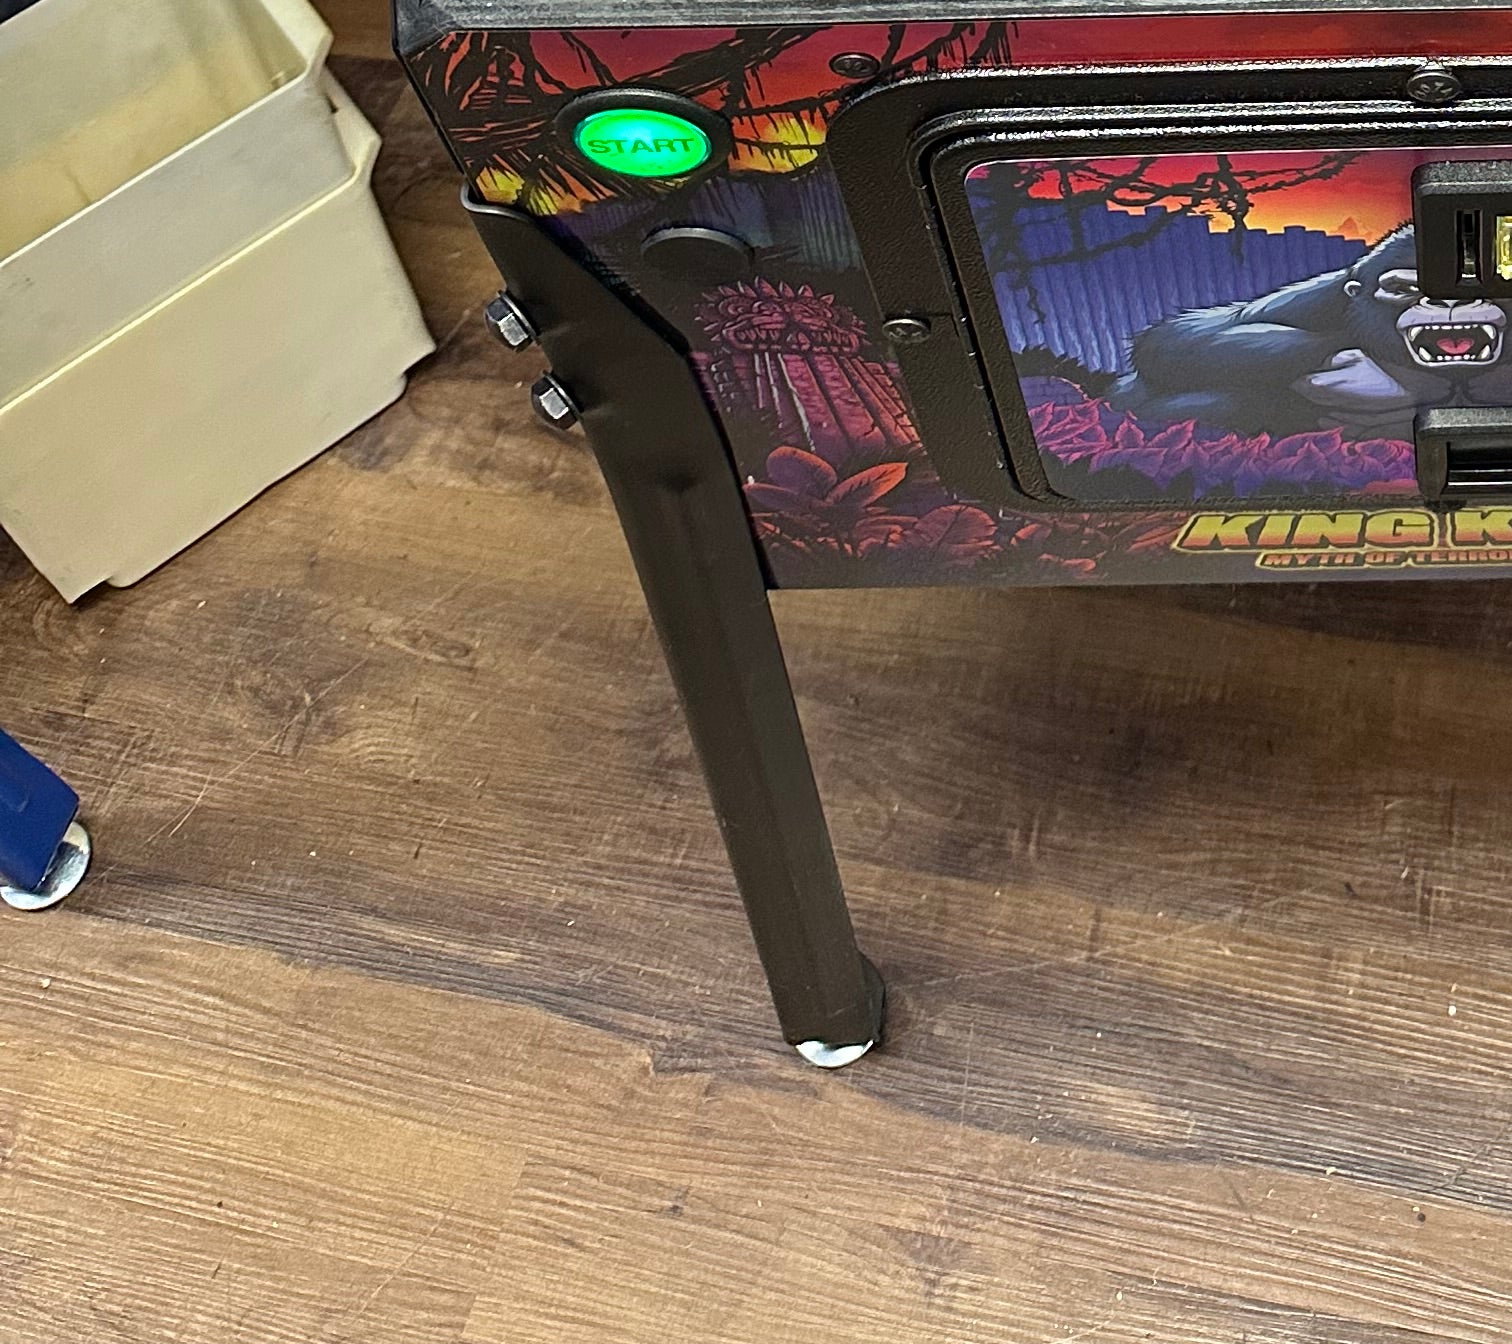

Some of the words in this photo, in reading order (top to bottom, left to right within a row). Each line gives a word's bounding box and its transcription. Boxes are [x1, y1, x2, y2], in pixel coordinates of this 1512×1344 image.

[587, 137, 694, 154] START
[1181, 512, 1434, 547] KING
[1264, 552, 1357, 566] MYTH
[1365, 552, 1401, 564] OF
